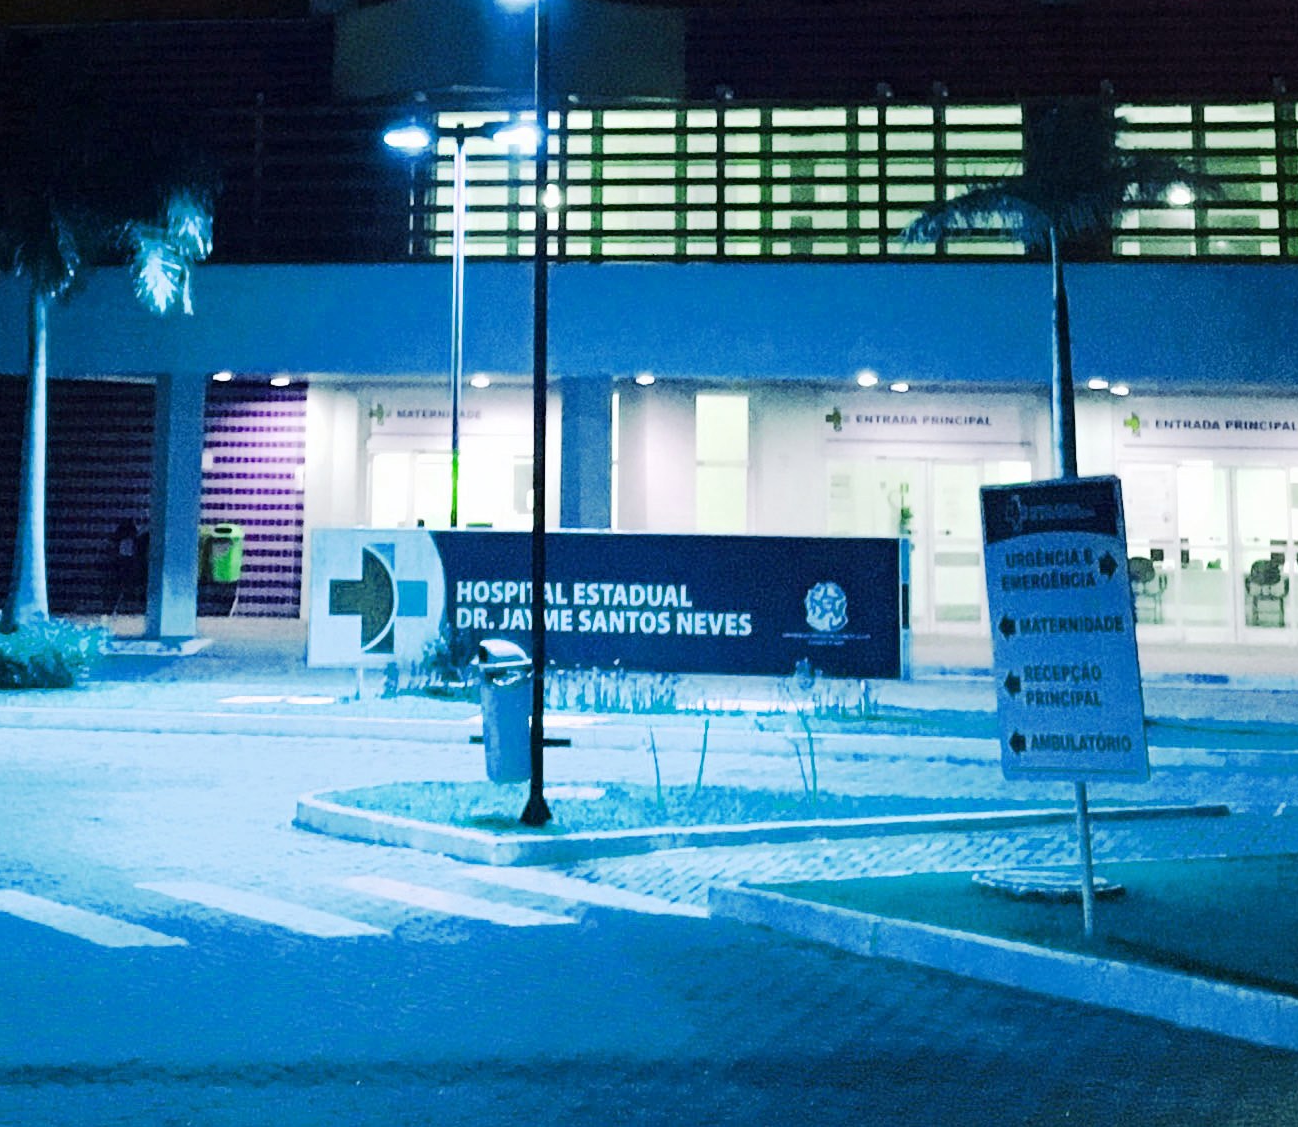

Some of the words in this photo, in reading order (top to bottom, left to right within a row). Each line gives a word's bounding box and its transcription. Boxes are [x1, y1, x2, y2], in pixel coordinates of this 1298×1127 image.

[396, 409, 481, 419] MATERNIADE
[855, 414, 918, 425] ENTRADA
[922, 415, 992, 426] PRINCIPAL
[1155, 419, 1221, 430] ENTRADA
[1225, 420, 1298, 431] PRINCIPAL
[456, 580, 568, 605] HOSPITAL
[573, 582, 693, 608] ESTADUAL
[456, 607, 495, 630] DR.
[498, 607, 573, 632] JAYME
[578, 609, 671, 635] SANTOS
[676, 612, 753, 637] NEVES
[1020, 615, 1125, 632] MATERNIDADE
[1023, 661, 1102, 684] RECEPÇÃO
[1025, 690, 1102, 706] PRINCIPAL
[1030, 732, 1133, 752] AMBULATÓRIO
